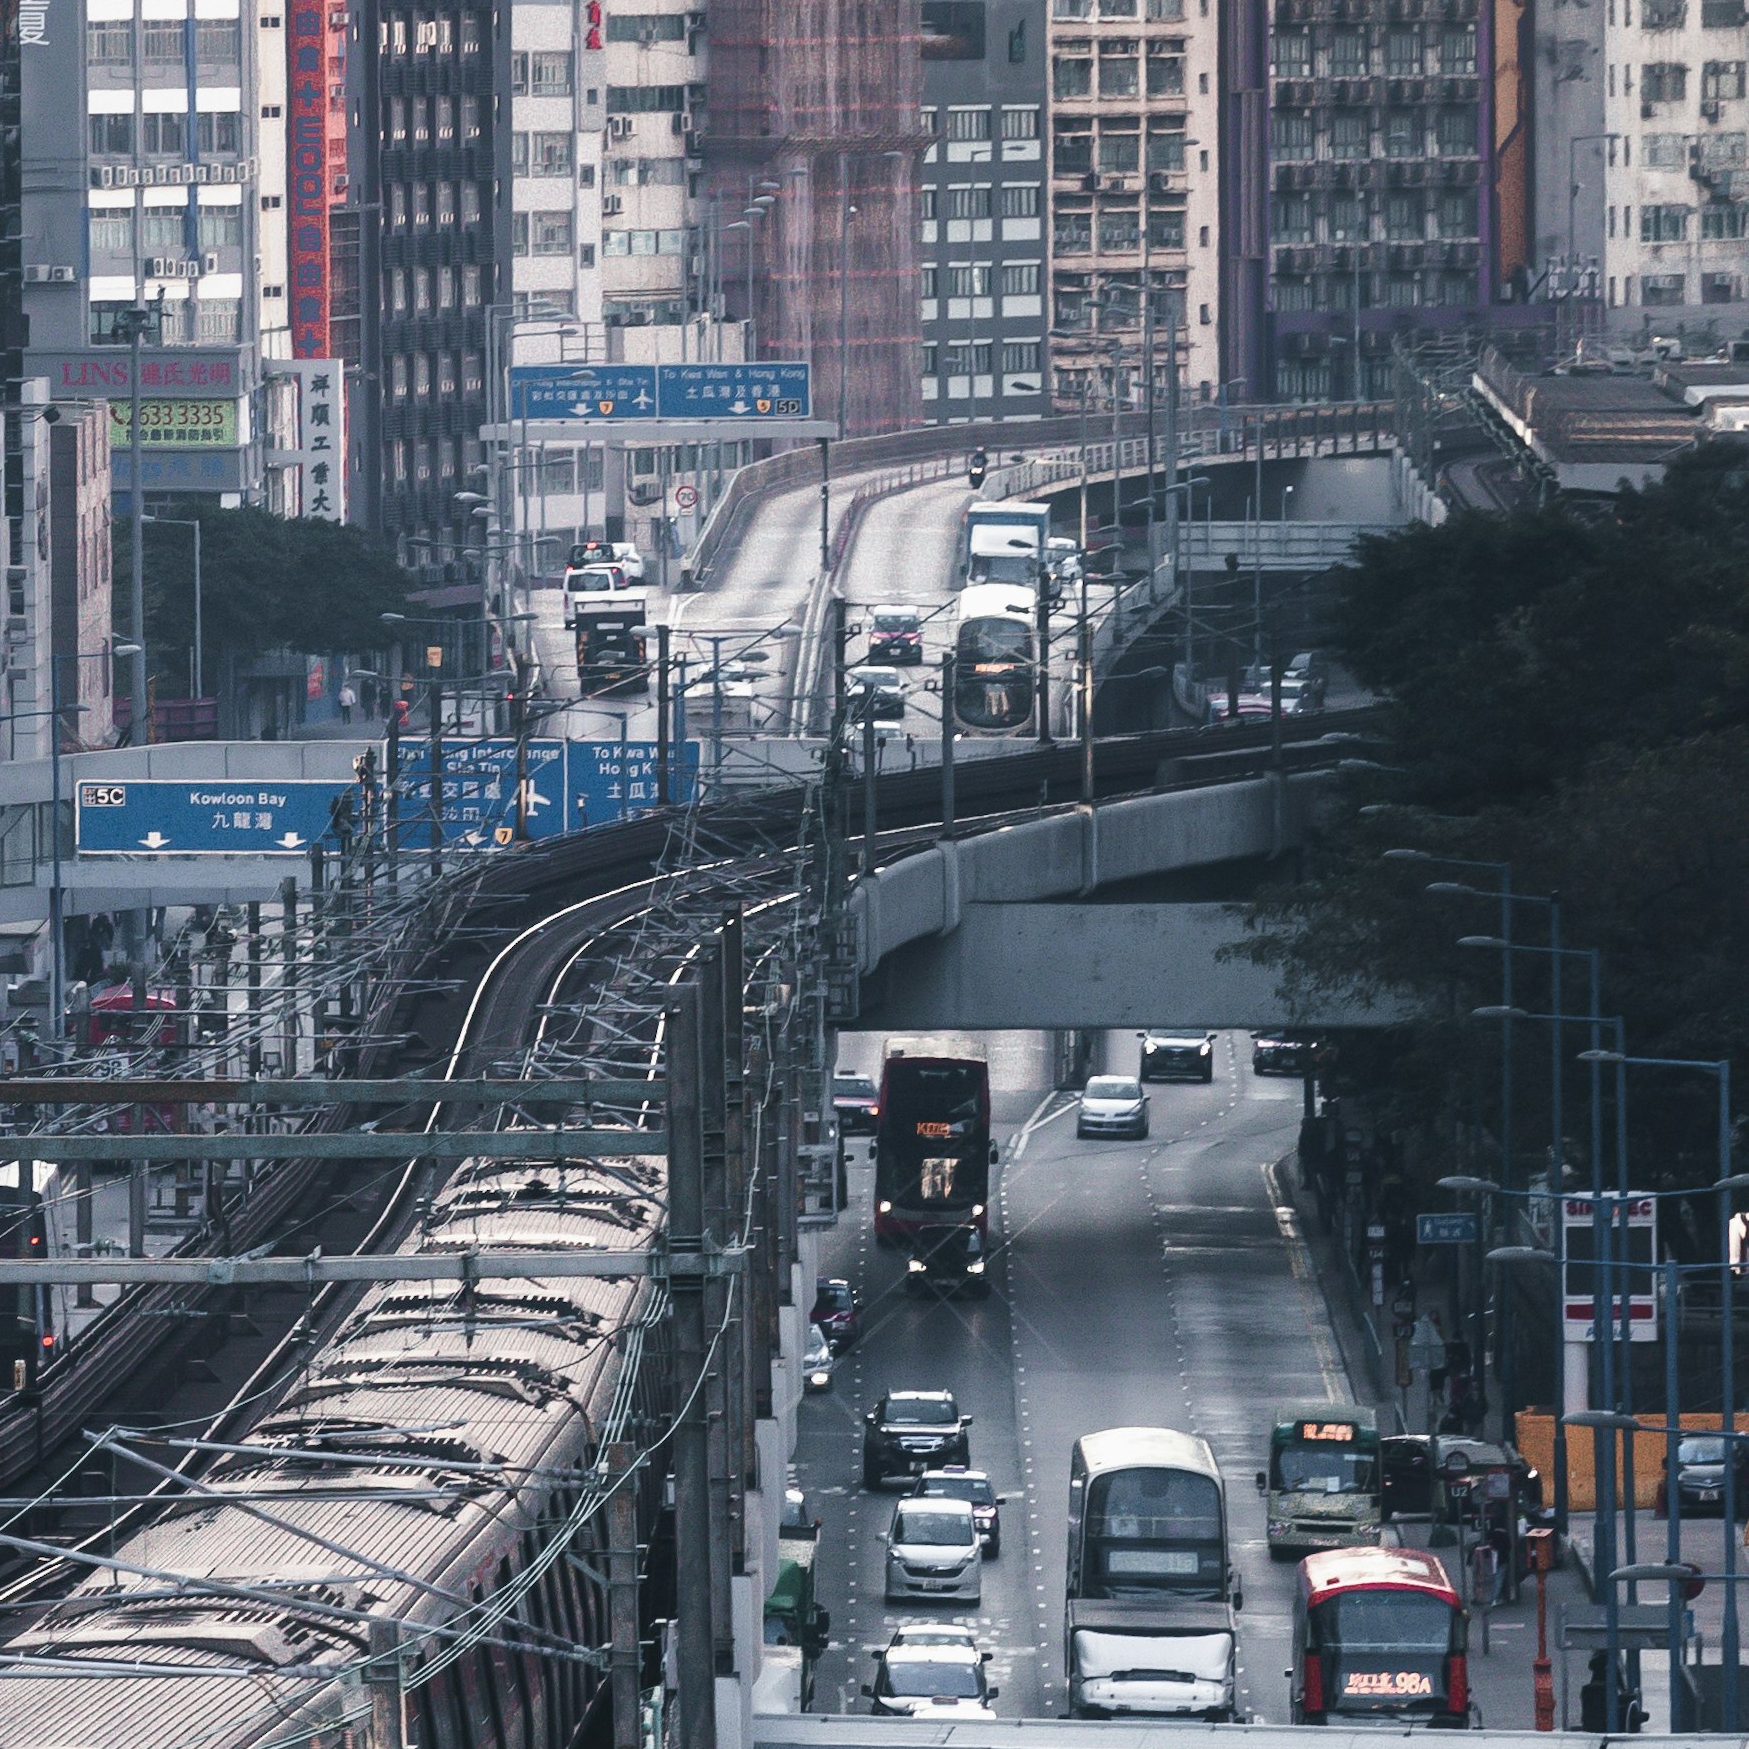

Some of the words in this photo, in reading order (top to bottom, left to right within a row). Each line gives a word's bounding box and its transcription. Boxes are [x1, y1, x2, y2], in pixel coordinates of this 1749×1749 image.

[663, 369, 676, 379] To
[749, 368, 776, 381] Hong
[780, 368, 805, 380] Kong
[178, 404, 224, 426] 3335
[778, 401, 799, 414] 5D
[472, 747, 561, 760] Intercange
[592, 747, 610, 759] To
[613, 746, 645, 759] Kwa
[479, 762, 501, 773] Tin
[599, 763, 639, 778] Hog
[96, 787, 124, 805] 5C
[190, 792, 254, 805] Kowloon
[258, 792, 287, 807] Bay
[211, 811, 273, 830] 九龍灣
[1566, 1201, 1652, 1216] SINEC
[1451, 1485, 1468, 1497] U2
[1395, 1671, 1432, 1694] 98A
